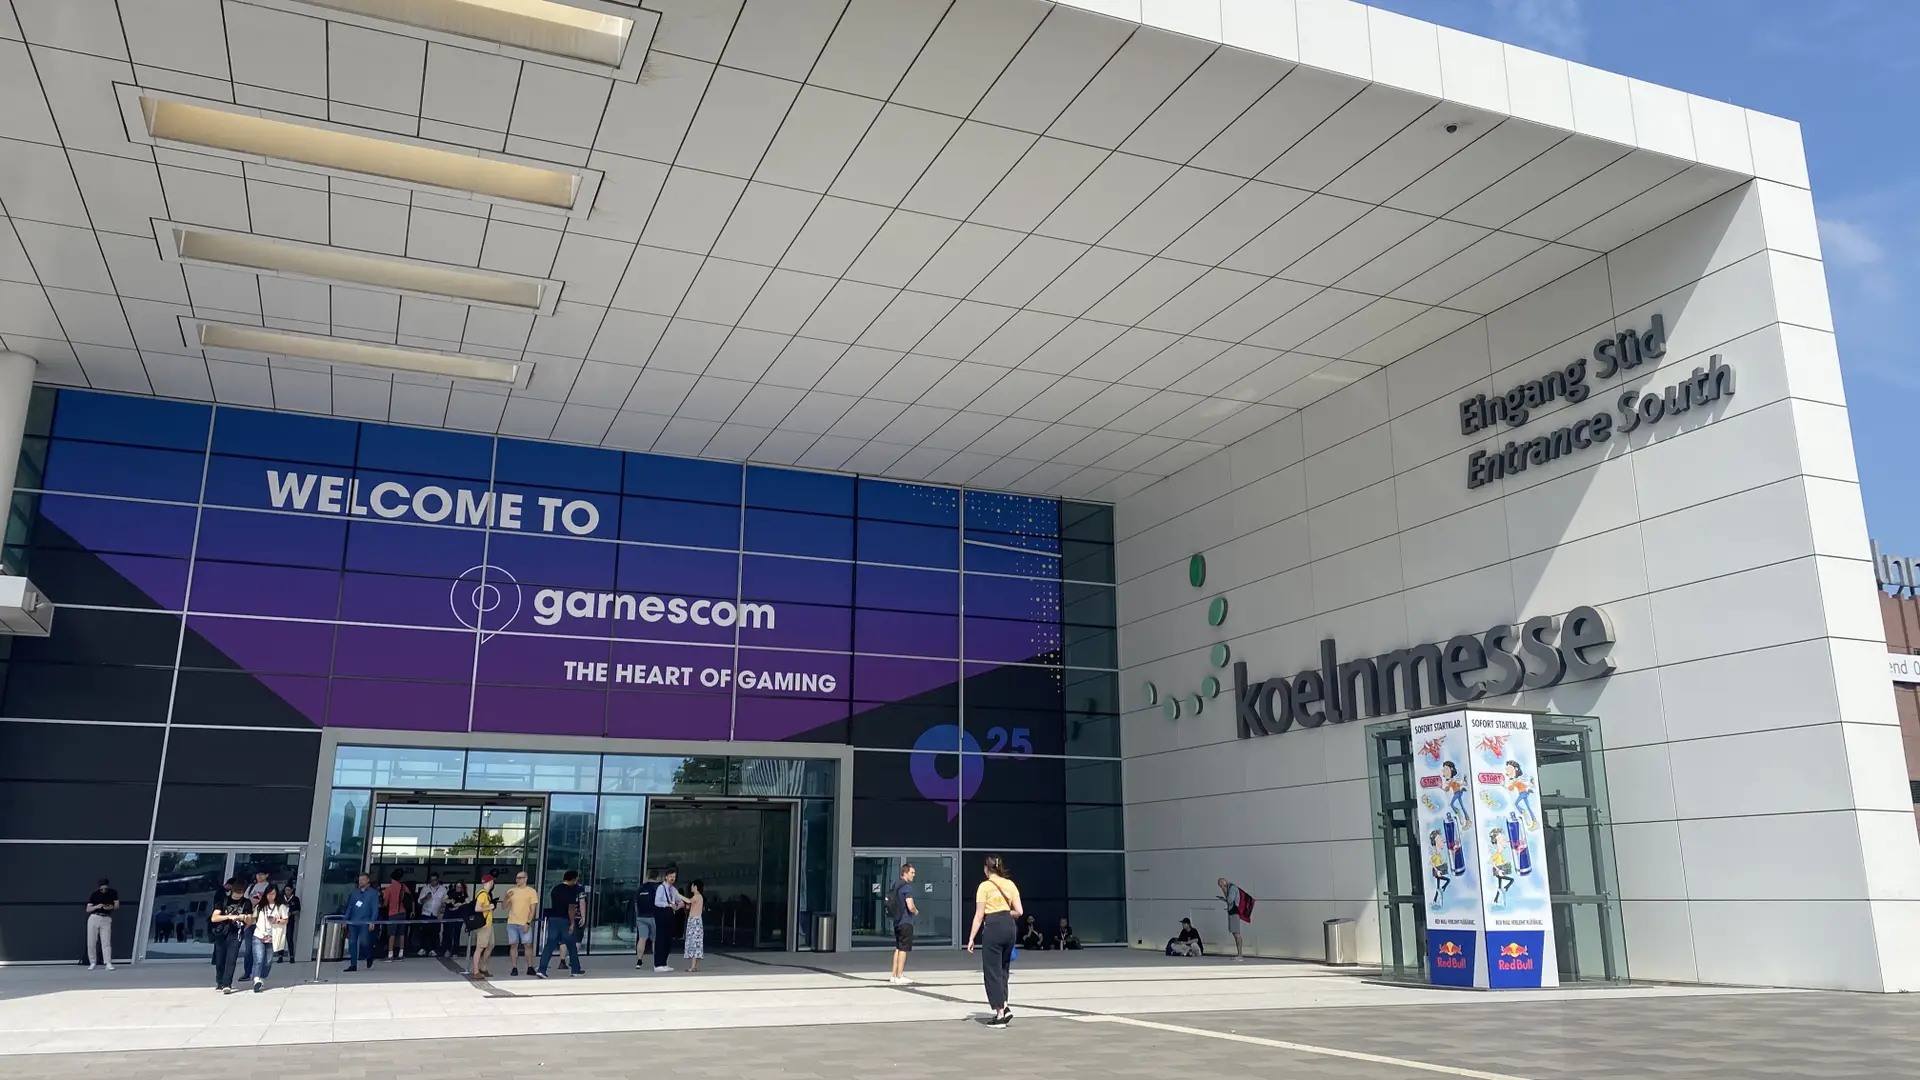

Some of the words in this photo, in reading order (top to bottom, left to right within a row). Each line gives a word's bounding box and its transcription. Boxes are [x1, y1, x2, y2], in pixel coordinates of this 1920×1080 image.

[1459, 356, 1590, 436] Eingang
[1592, 314, 1666, 380] Süd
[1467, 410, 1612, 490] Entrance
[1617, 354, 1735, 434] South
[265, 470, 523, 530] WELCOME
[537, 496, 600, 535] TO
[533, 587, 776, 630] gamescom
[564, 660, 609, 683] THE
[615, 663, 694, 687] HEART
[700, 667, 732, 688] OF
[737, 669, 837, 694] GAMING
[1234, 605, 1616, 738] koelnmesse
[1414, 723, 1433, 735] SOFORT
[1434, 719, 1463, 731] STARTKLAR.
[1471, 719, 1494, 728] SOFORT
[1495, 720, 1529, 730] STARTKLAR.
[987, 726, 1033, 761] 25
[1437, 957, 1451, 968] Red
[1452, 957, 1466, 969] Bull
[1498, 959, 1516, 970] Red
[1517, 959, 1533, 970] Bull
